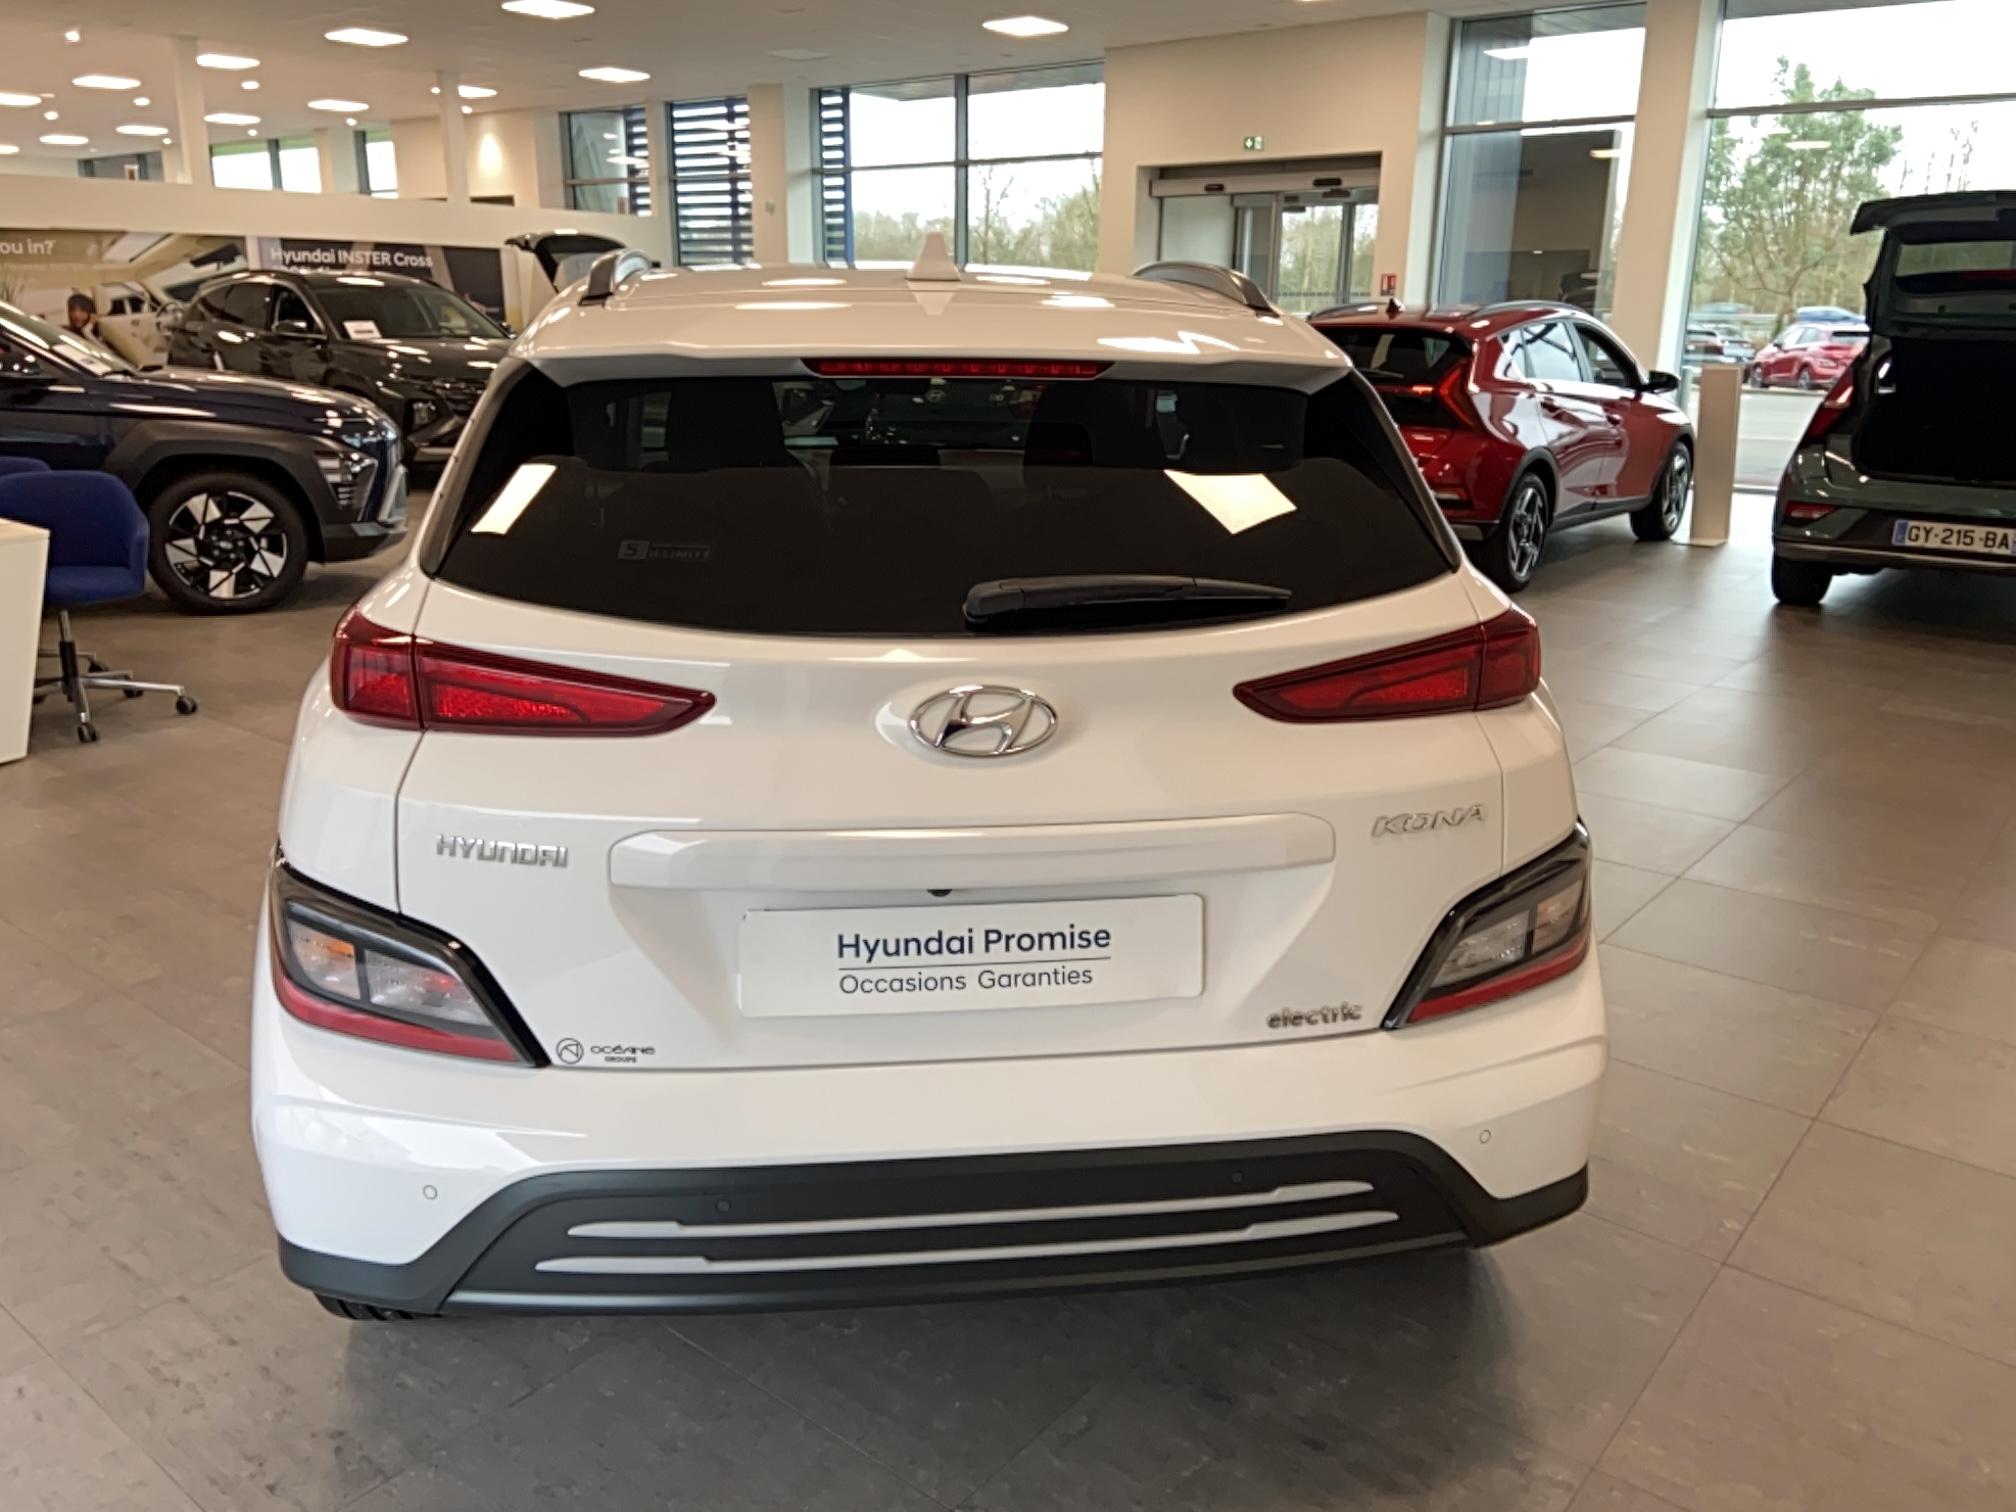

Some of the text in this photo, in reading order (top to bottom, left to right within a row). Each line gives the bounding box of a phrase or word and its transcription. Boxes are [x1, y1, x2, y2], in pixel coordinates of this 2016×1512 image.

[0, 238, 54, 255] ou in?
[270, 247, 434, 267] Hyundai INSTER Cross
[1908, 525, 2010, 550] GY-215-BA
[1370, 803, 1484, 838] KONA
[436, 834, 568, 868] HYUNDAI
[837, 924, 1111, 963] Hyundai Promise
[839, 965, 1093, 994] Occasions Garanties
[1266, 1001, 1363, 1029] electric
